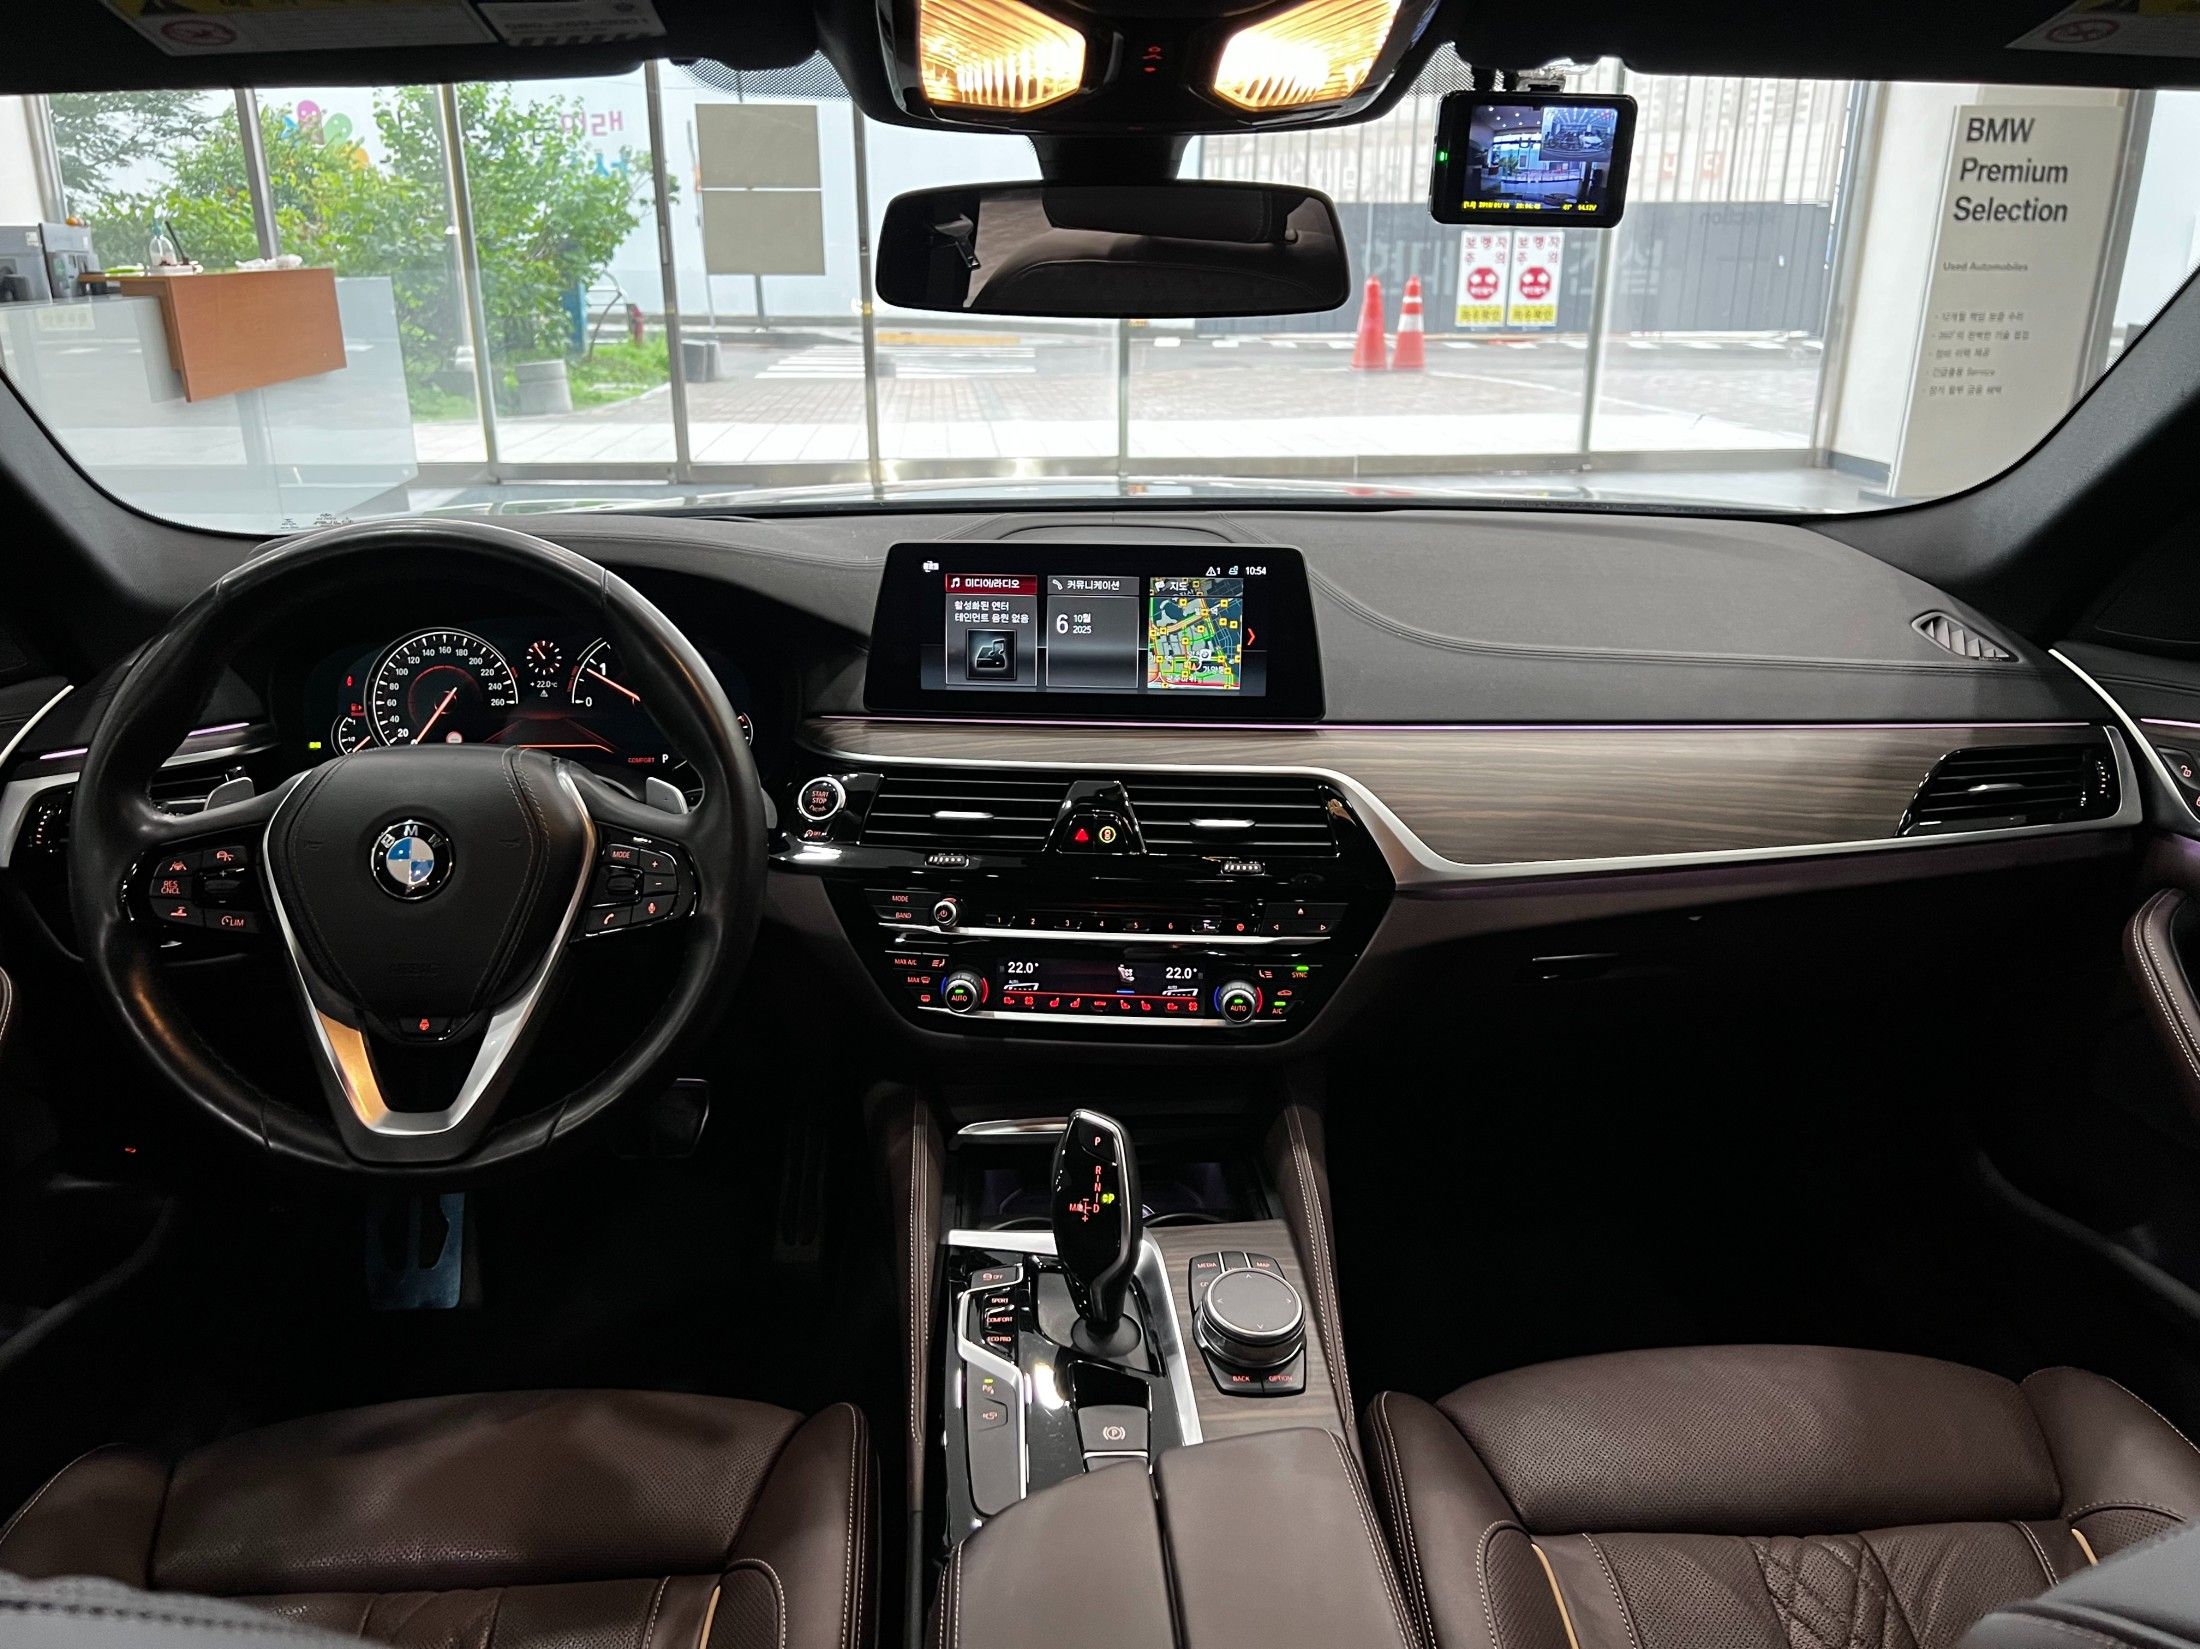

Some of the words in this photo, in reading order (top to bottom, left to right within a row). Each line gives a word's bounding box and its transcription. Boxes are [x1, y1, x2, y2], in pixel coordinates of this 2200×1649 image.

[1966, 117, 2035, 143] BMW
[1960, 157, 2068, 184] Premium
[1953, 196, 2068, 223] Selection
[1943, 261, 1968, 271] Used
[1970, 261, 2028, 271] Automobiles
[1245, 566, 1267, 576] 10:54
[964, 578, 1020, 590] 미디어/라디오
[1066, 579, 1120, 591] 커뮤니케이션
[1169, 581, 1188, 592] 지도
[954, 600, 990, 612] 활성화된
[991, 600, 1010, 612] 엔터
[954, 612, 990, 624] 테인먼트
[991, 612, 1010, 624] 음원
[1011, 613, 1030, 625] 없음
[1073, 613, 1092, 624] 10월
[1055, 613, 1069, 634] 6
[1072, 625, 1092, 635] 2025
[422, 649, 435, 657] 140
[439, 646, 452, 654] 160
[455, 649, 469, 657] 180
[407, 656, 420, 664] 120
[469, 657, 483, 665] 200
[395, 668, 409, 676] 100
[480, 668, 495, 676] 220
[599, 662, 606, 676] 1
[389, 683, 400, 691] 80
[488, 682, 502, 691] 240
[386, 698, 397, 707] 60
[490, 698, 505, 706] 260
[585, 696, 593, 707] 0
[389, 715, 400, 723] 40
[397, 728, 409, 737] 20
[662, 753, 669, 764] P
[811, 790, 830, 798] START
[380, 824, 447, 849] BMW
[611, 850, 631, 859] MODE
[163, 880, 179, 888] RES
[160, 887, 181, 895] CNCL
[892, 895, 909, 903] MODE
[895, 911, 912, 919] BAND
[230, 918, 245, 927] LIM
[1030, 917, 1036, 925] 2
[1064, 919, 1070, 927] 3
[1099, 920, 1104, 928] 4
[1133, 921, 1139, 929] 5
[1168, 922, 1173, 930] 6
[1007, 961, 1040, 974] 22.0°
[1165, 966, 1198, 980] 22.0°
[1291, 971, 1308, 979] SYNC
[907, 976, 920, 984] MAX
[951, 994, 968, 1002] AUTO
[1230, 1004, 1247, 1012] AUTO
[1272, 1007, 1283, 1015] A/C
[1094, 1136, 1101, 1146] P
[1095, 1165, 1102, 1175] R
[1094, 1182, 1101, 1192] N
[1093, 1203, 1100, 1213] D
